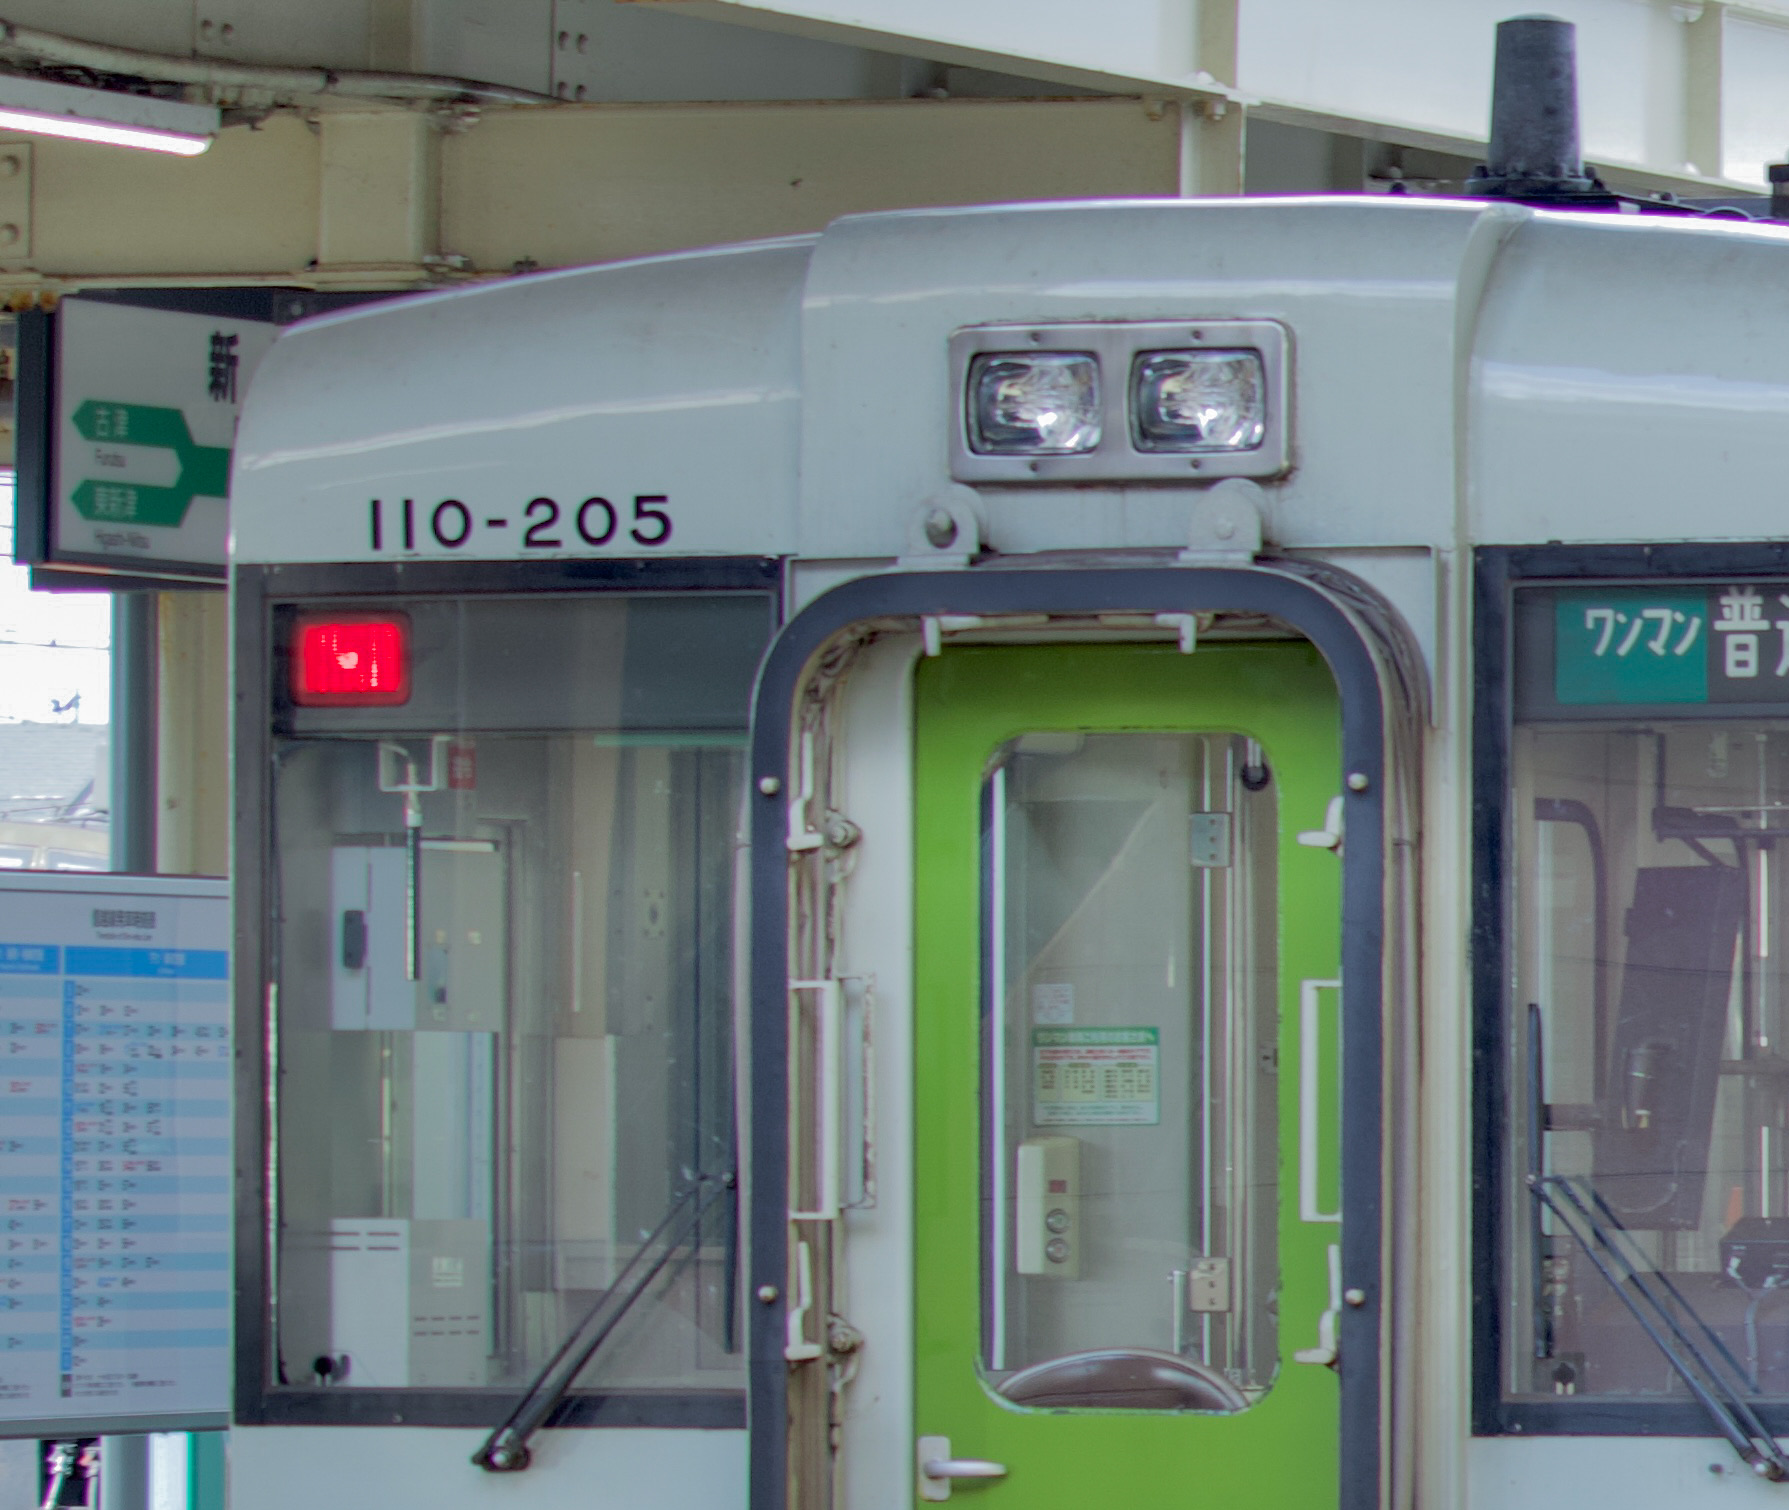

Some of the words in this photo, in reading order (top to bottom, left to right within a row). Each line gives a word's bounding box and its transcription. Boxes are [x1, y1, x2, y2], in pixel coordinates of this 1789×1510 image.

[371, 495, 673, 551] 110-205
[1585, 607, 1701, 657] ワンマン
